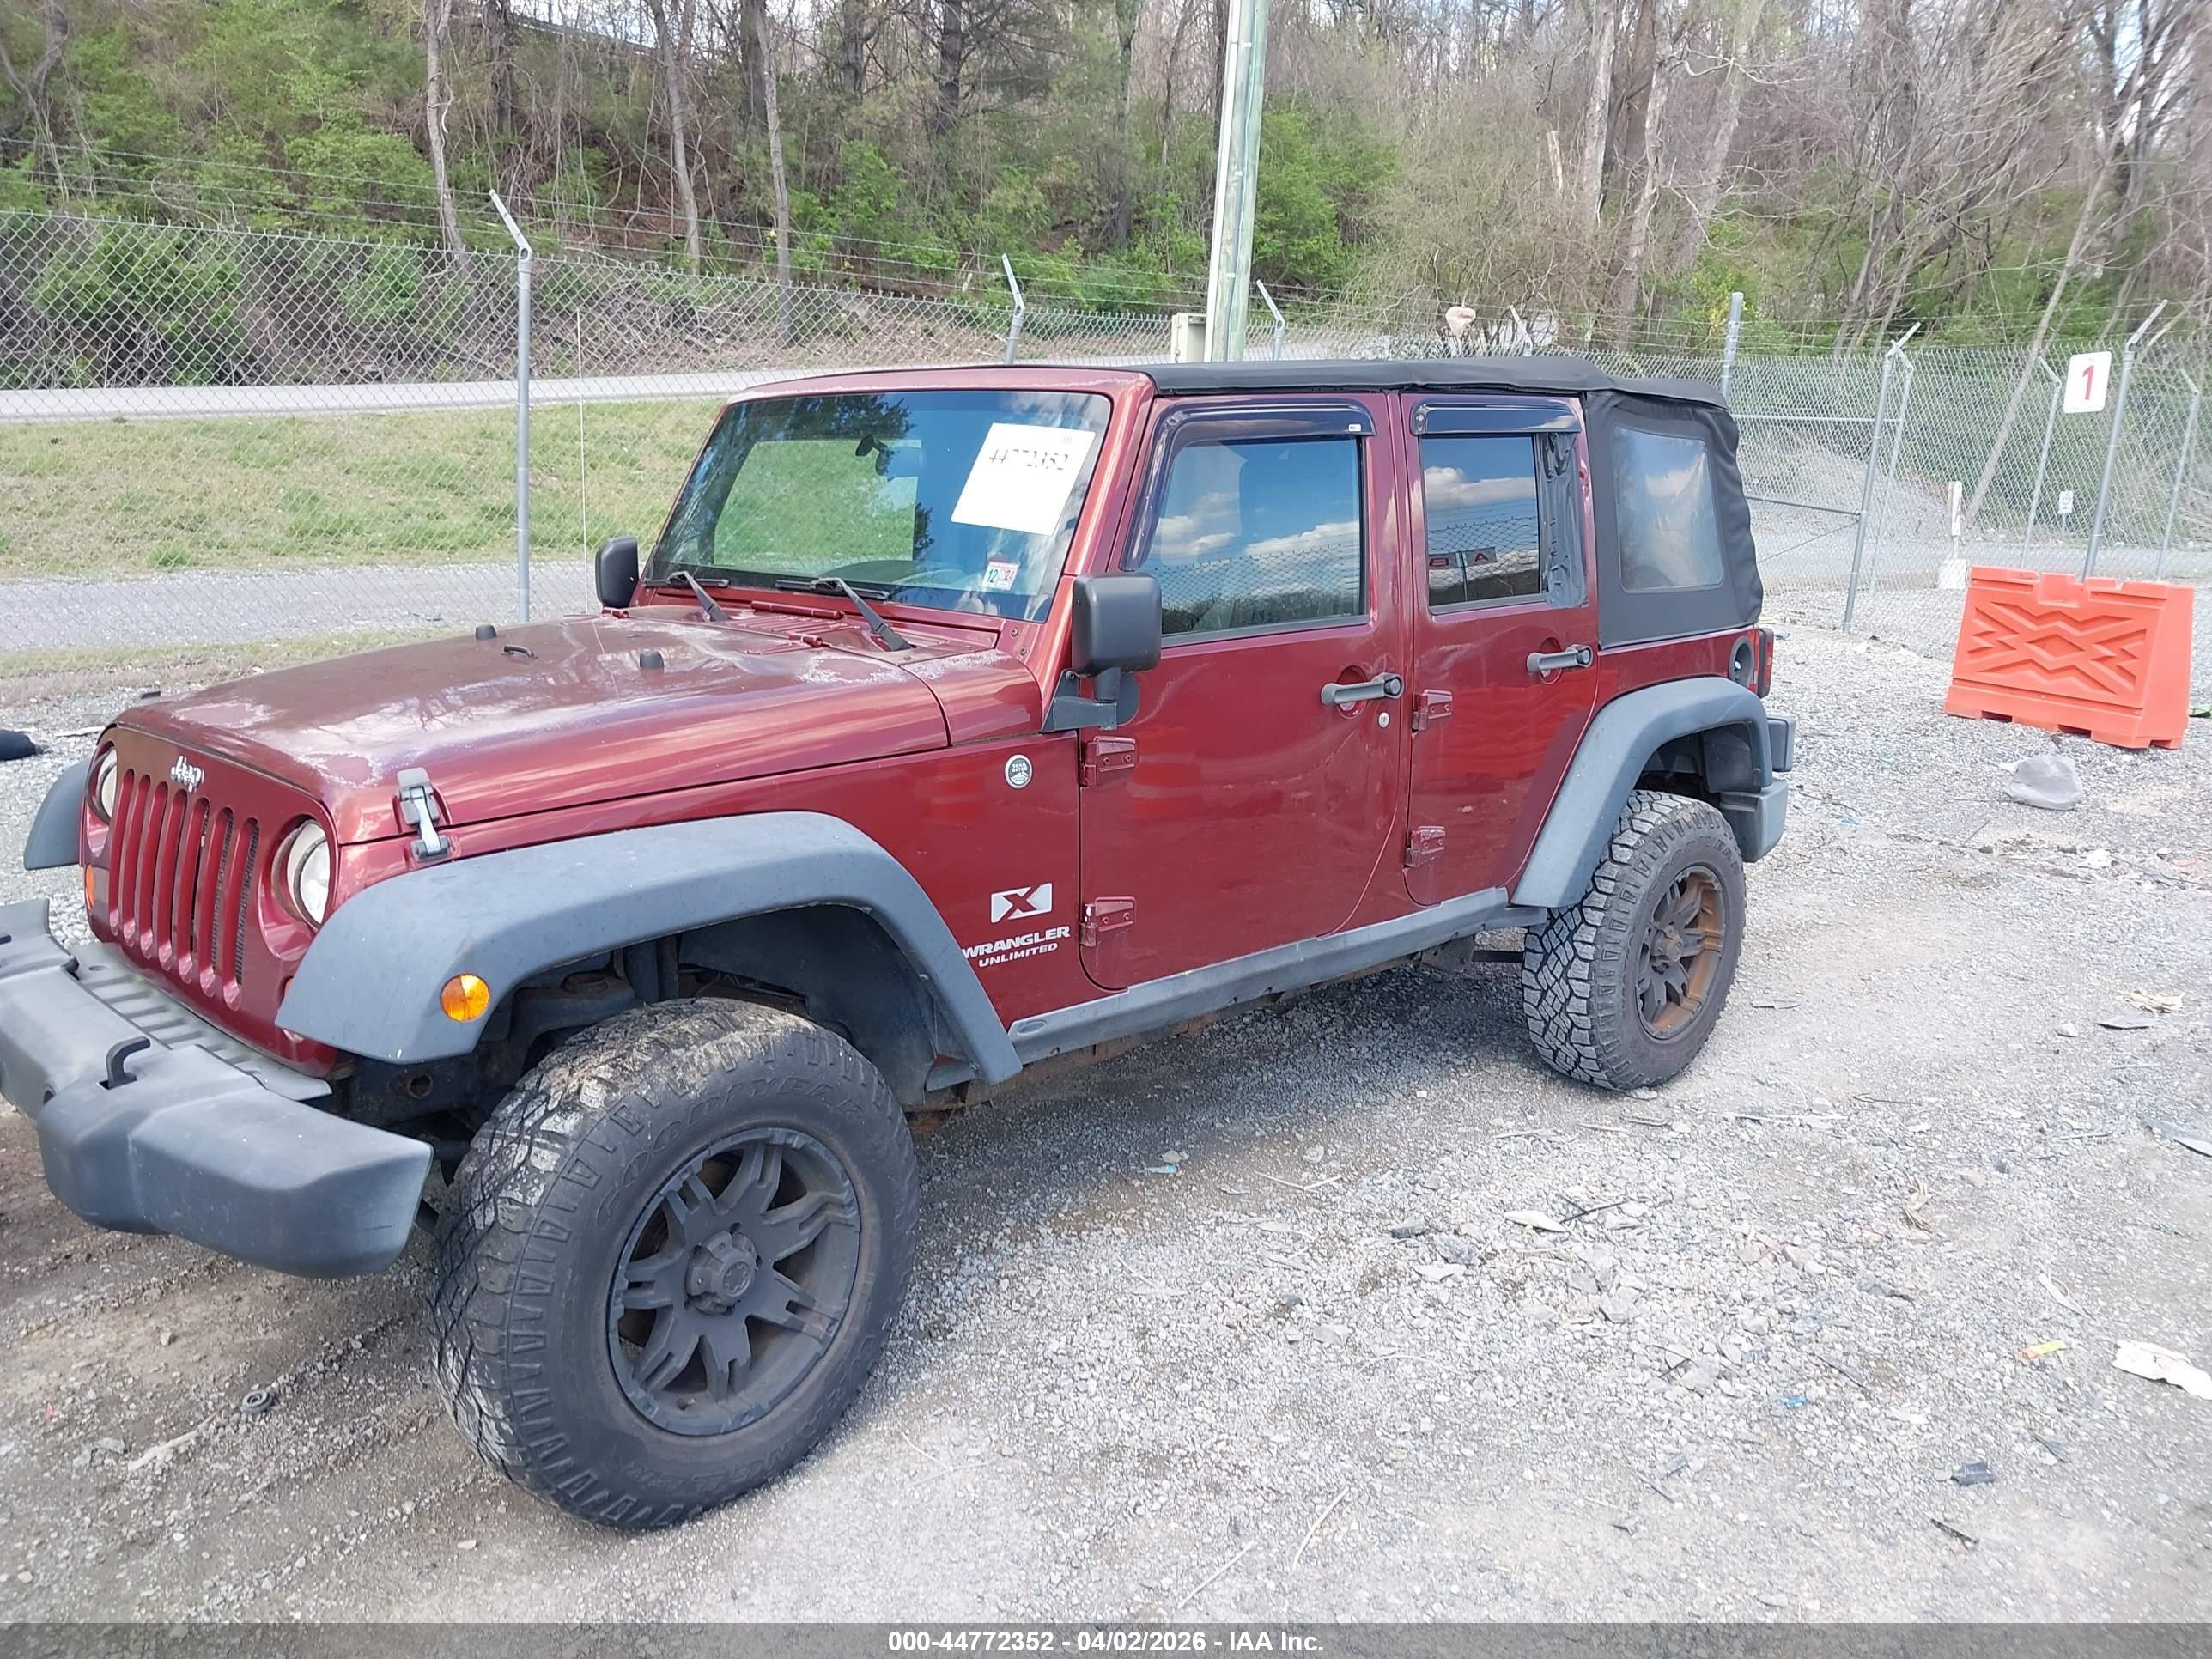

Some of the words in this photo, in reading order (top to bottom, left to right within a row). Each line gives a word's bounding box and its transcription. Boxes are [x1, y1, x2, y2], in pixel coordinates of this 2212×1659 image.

[2081, 364, 2095, 401] 1
[961, 925, 1071, 959] WRANGLER
[978, 942, 1059, 968] UNLIMITED
